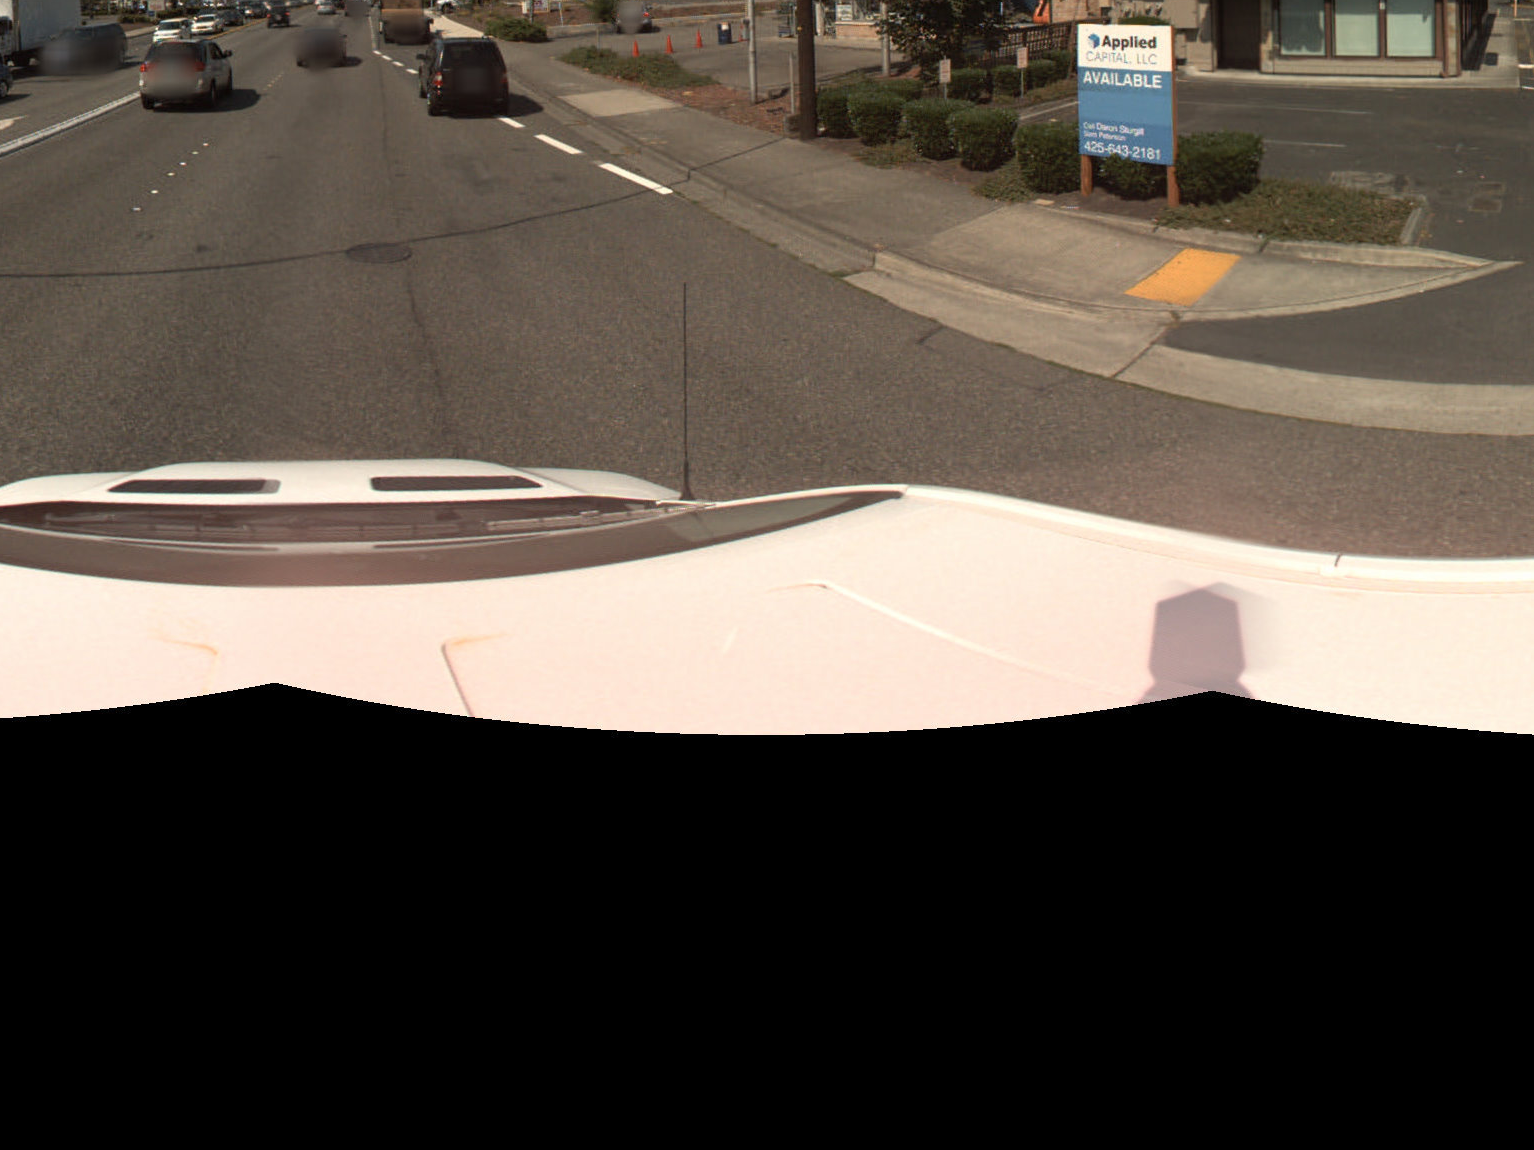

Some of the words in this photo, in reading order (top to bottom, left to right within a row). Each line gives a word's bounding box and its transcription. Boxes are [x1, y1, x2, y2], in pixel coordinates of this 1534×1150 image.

[1102, 35, 1157, 50] Applied
[1136, 53, 1157, 65] LLC
[1083, 70, 1163, 89] AVAILABLE
[1084, 141, 1161, 160] 425-643-2181
